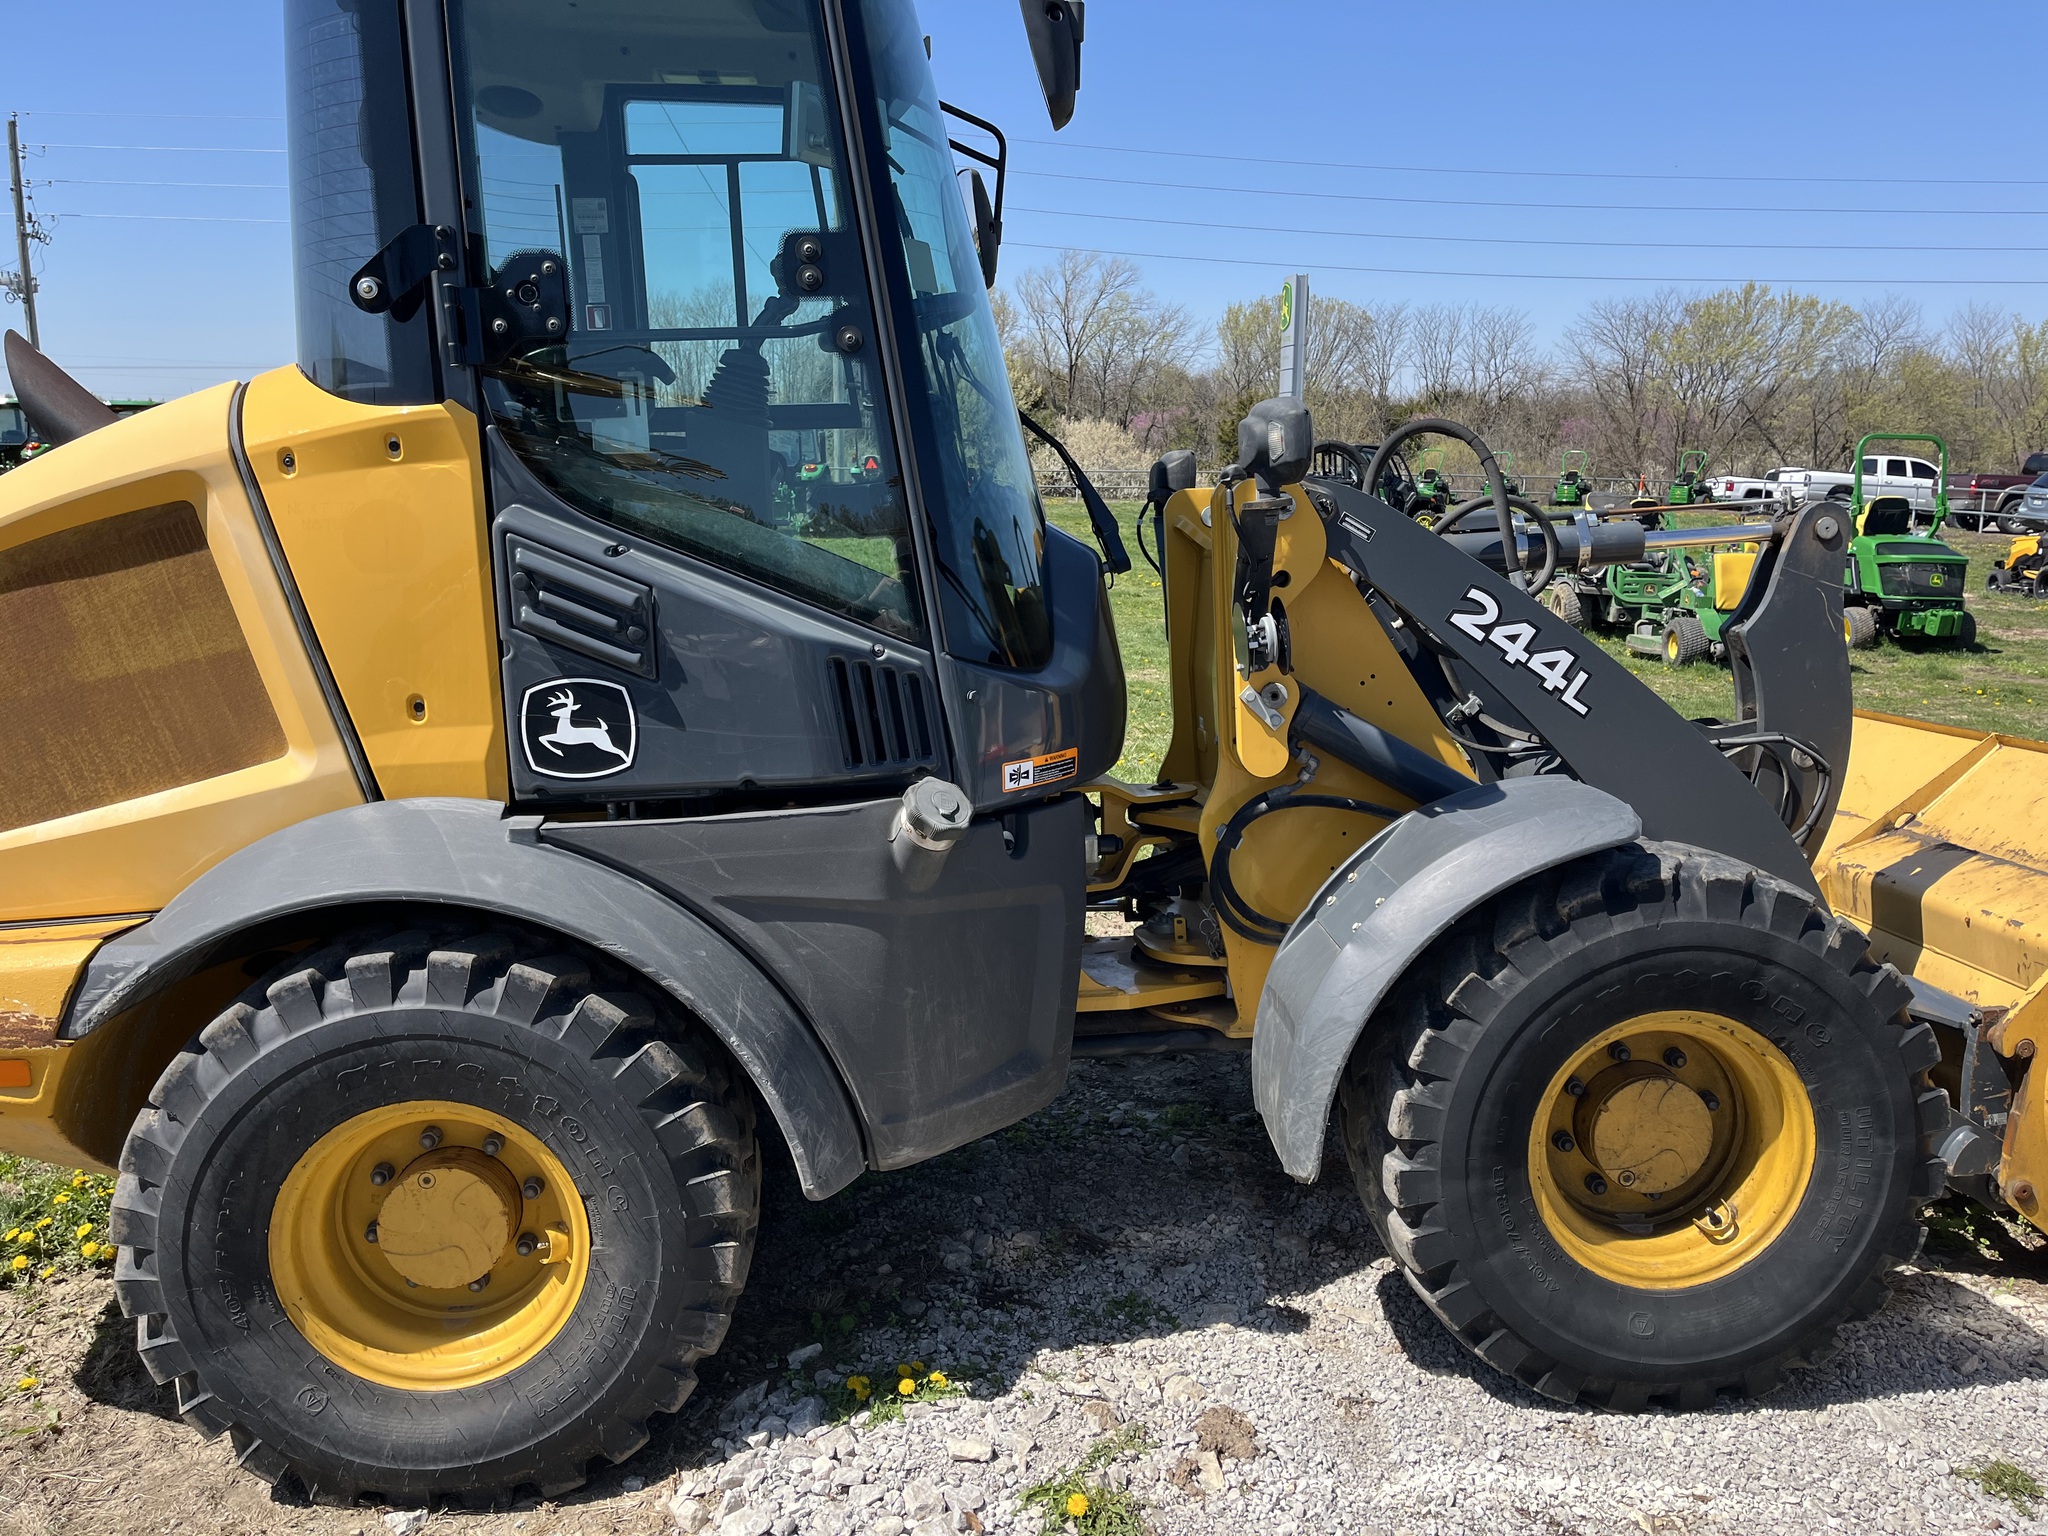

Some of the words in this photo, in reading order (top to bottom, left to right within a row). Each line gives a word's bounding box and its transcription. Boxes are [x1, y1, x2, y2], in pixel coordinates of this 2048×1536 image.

[1448, 587, 1590, 717] 244L
[1825, 1105, 1875, 1255] UTILITY
[535, 1284, 638, 1419] UTILITY
